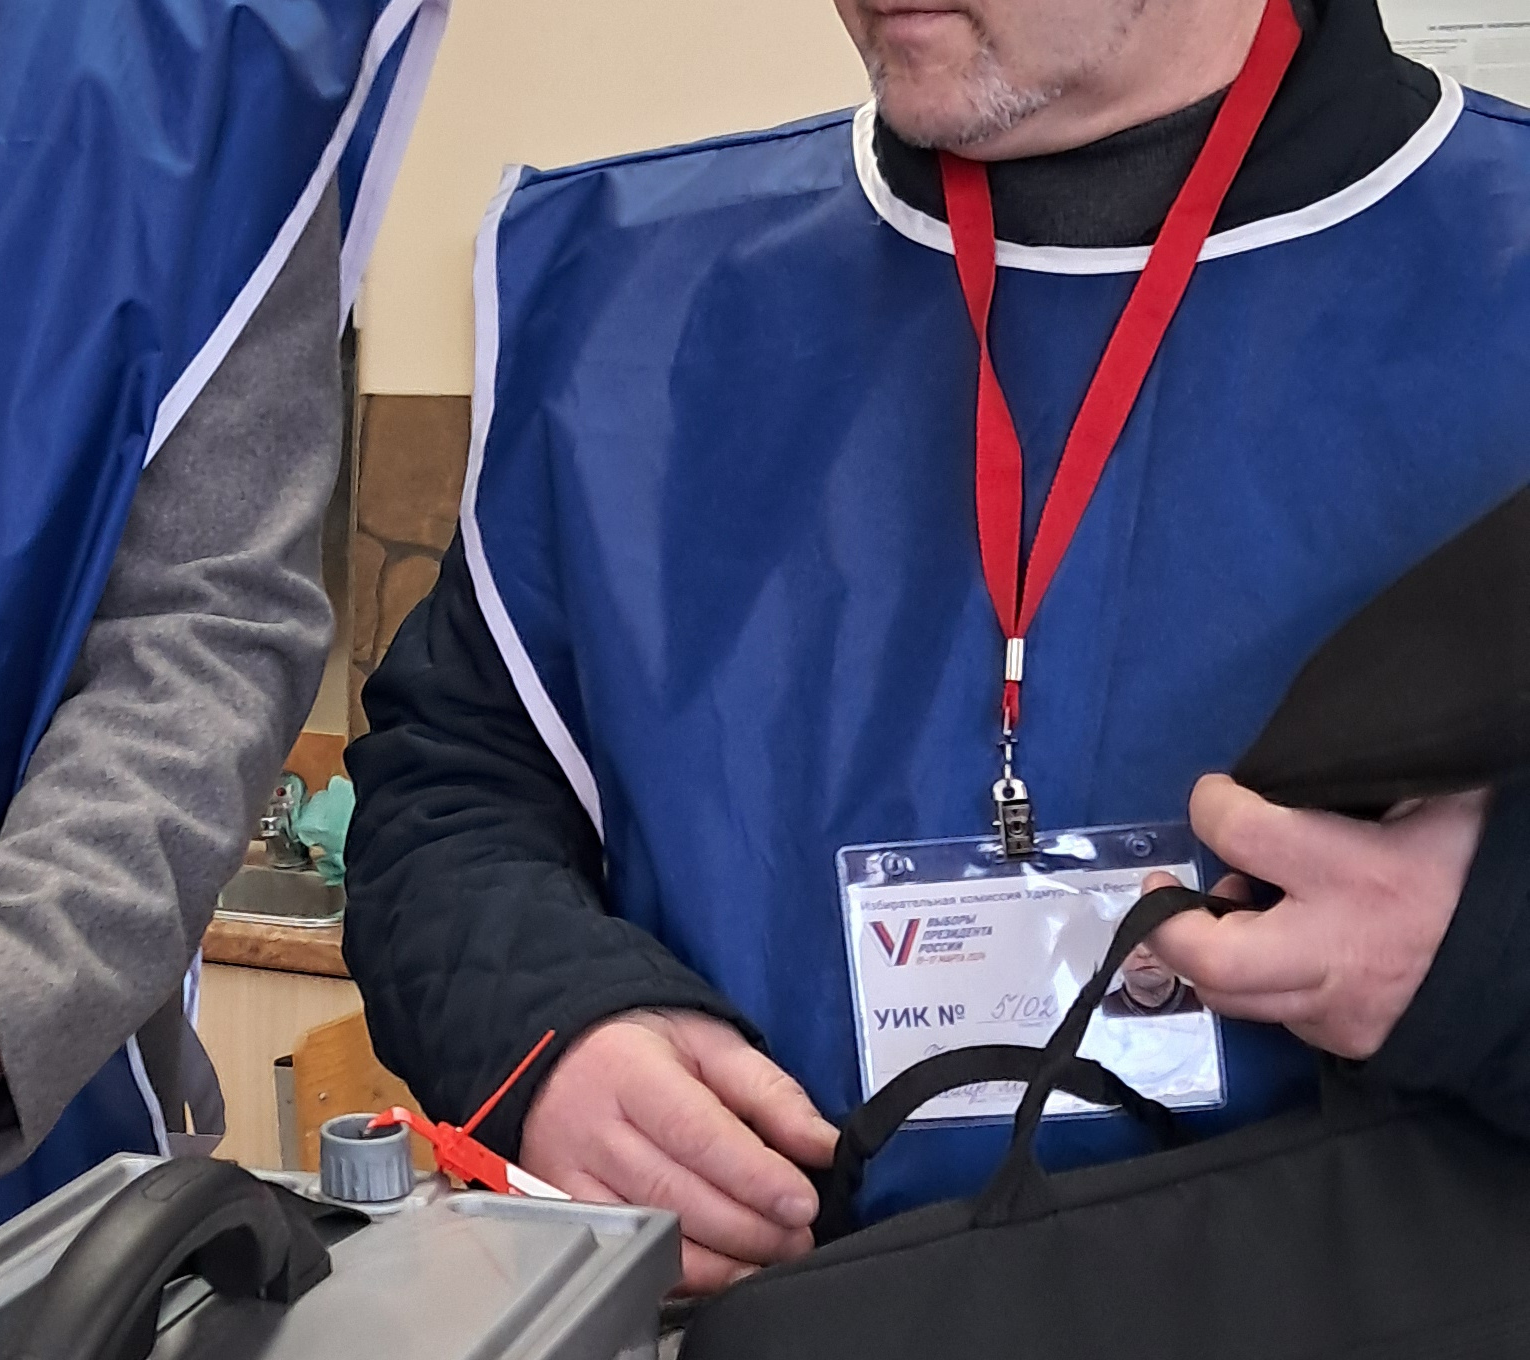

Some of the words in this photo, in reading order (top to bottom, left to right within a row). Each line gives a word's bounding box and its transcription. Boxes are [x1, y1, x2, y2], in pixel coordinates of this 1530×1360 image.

[927, 914, 977, 928] ВЫБОРЫ
[922, 926, 993, 941] ПРЕЗИДЕНТА
[918, 941, 964, 953] РОССИИ
[873, 1005, 931, 1031] УИК
[938, 1003, 966, 1027] №
